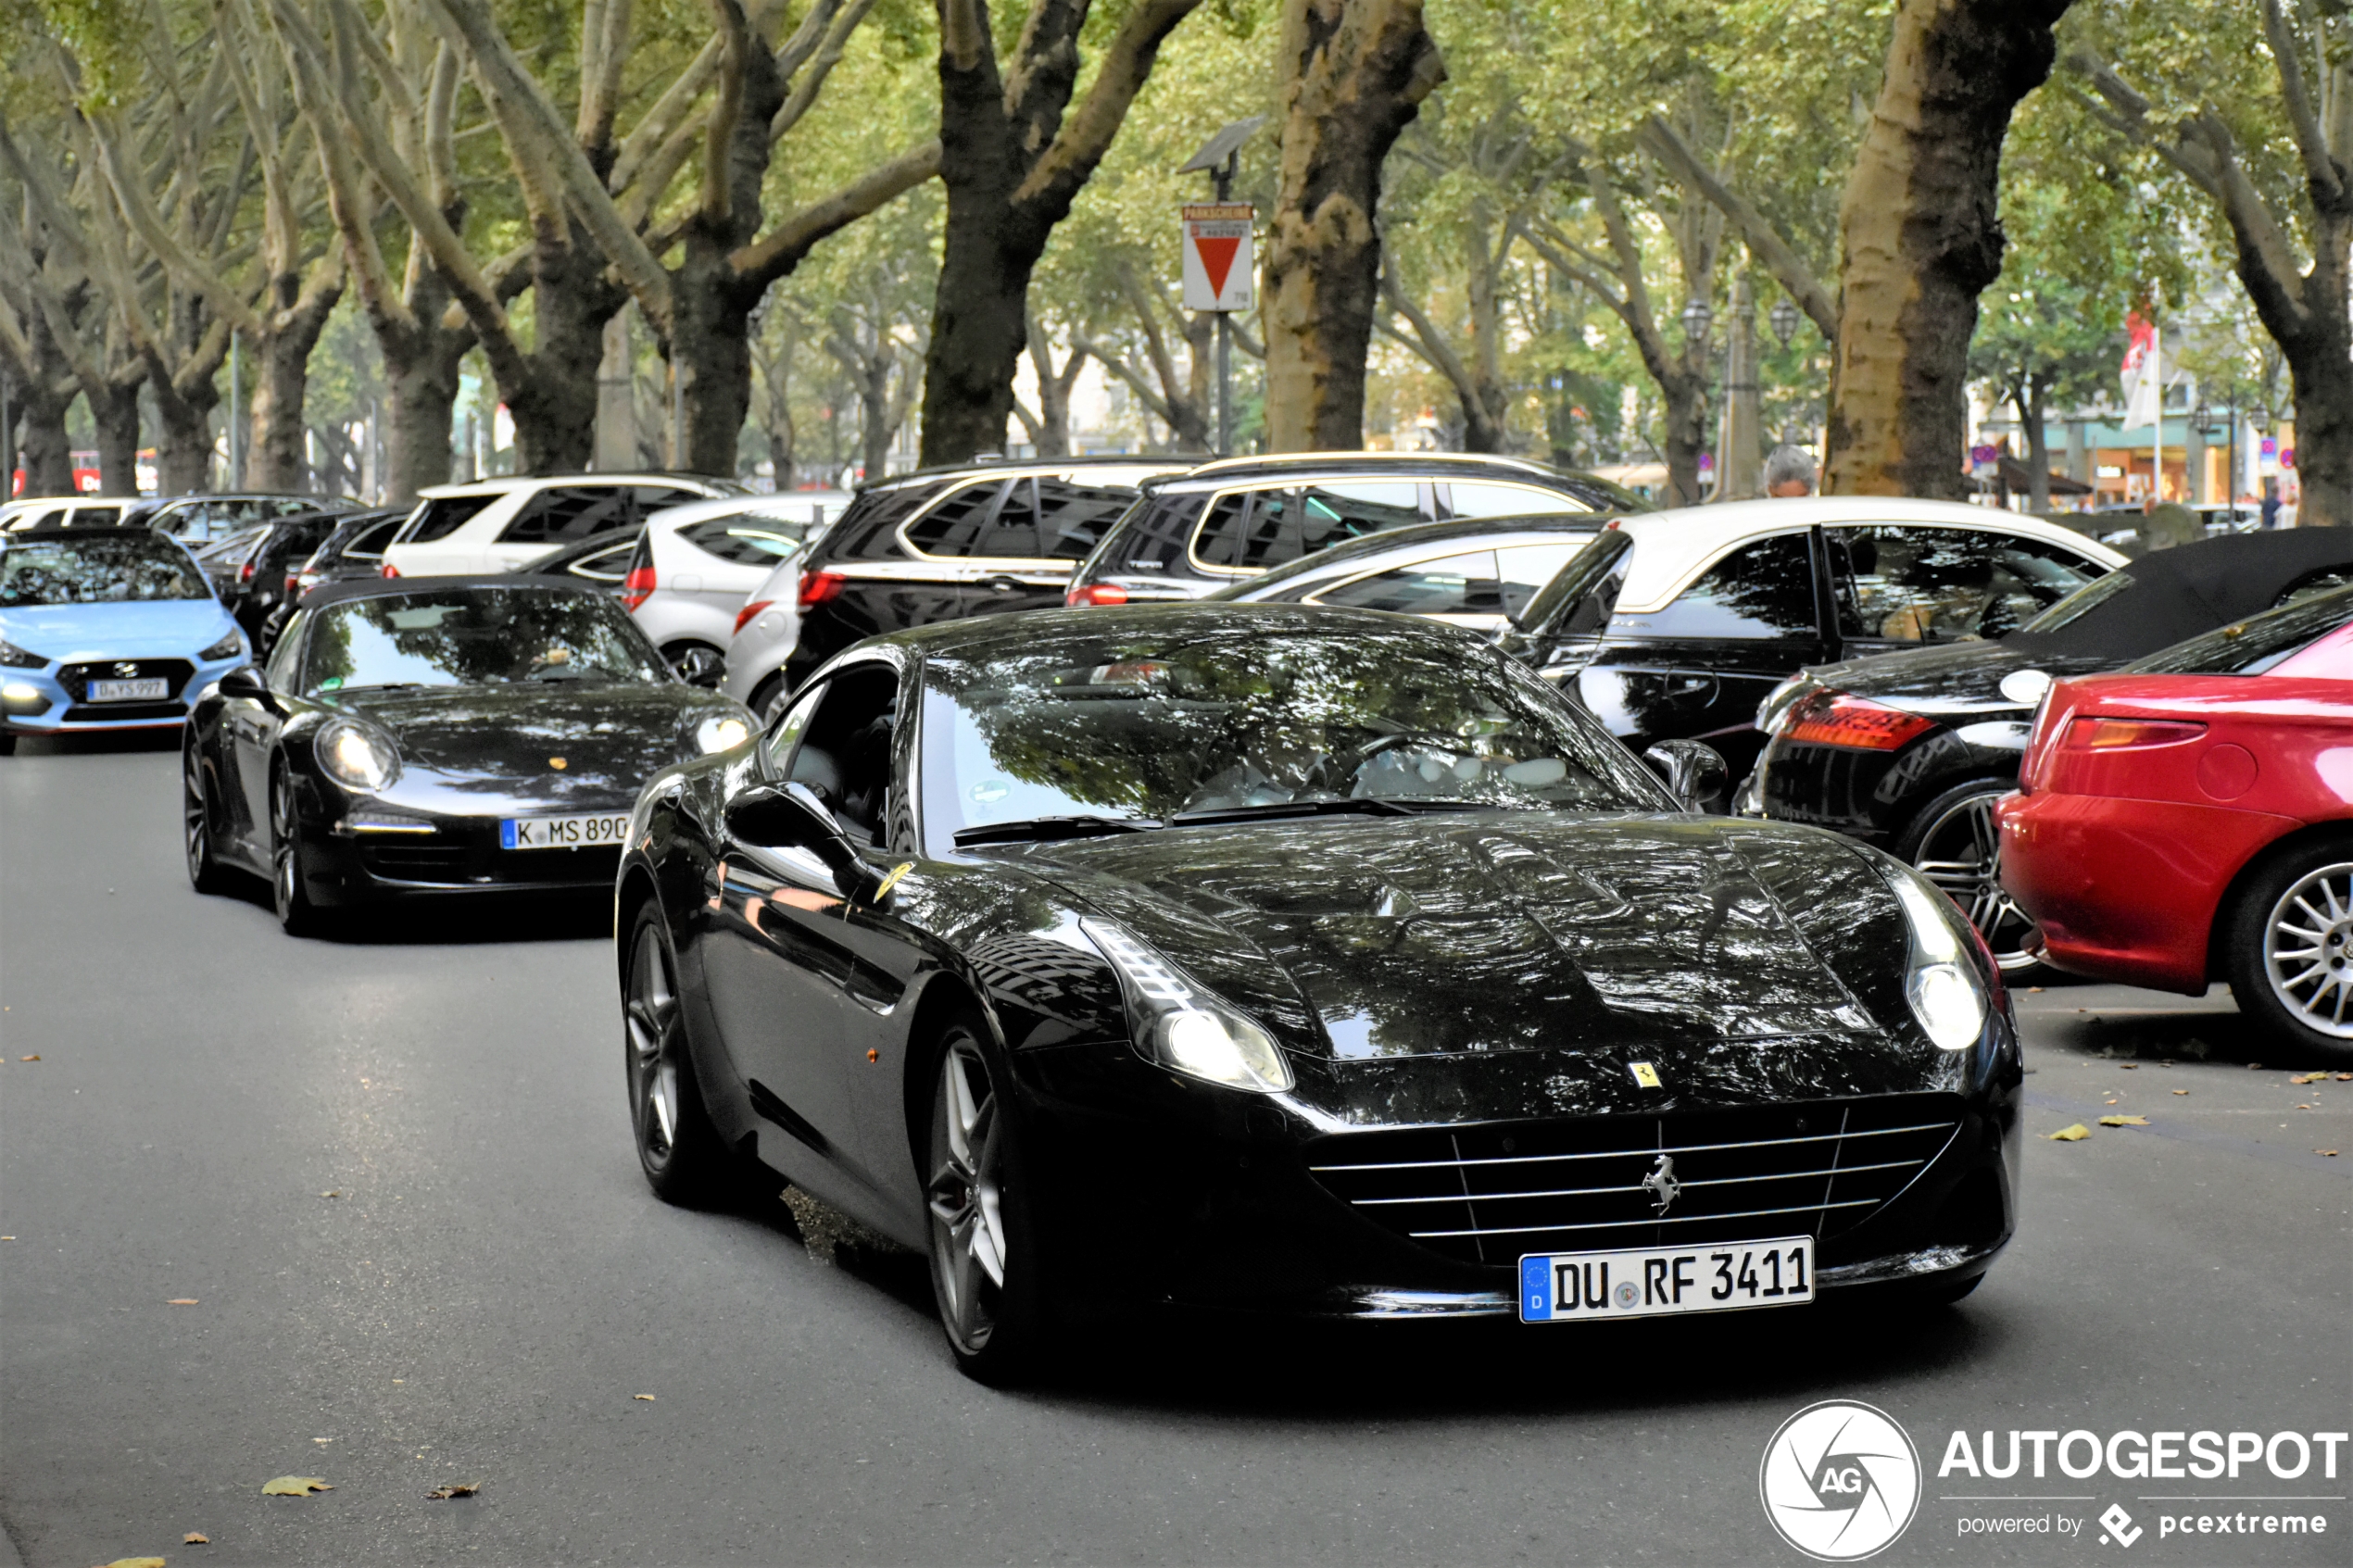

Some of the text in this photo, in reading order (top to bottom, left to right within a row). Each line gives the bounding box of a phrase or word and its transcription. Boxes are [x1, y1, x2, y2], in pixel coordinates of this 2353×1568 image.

[518, 817, 627, 845] K MS 890
[1532, 1247, 1809, 1311] D DU RF 3411
